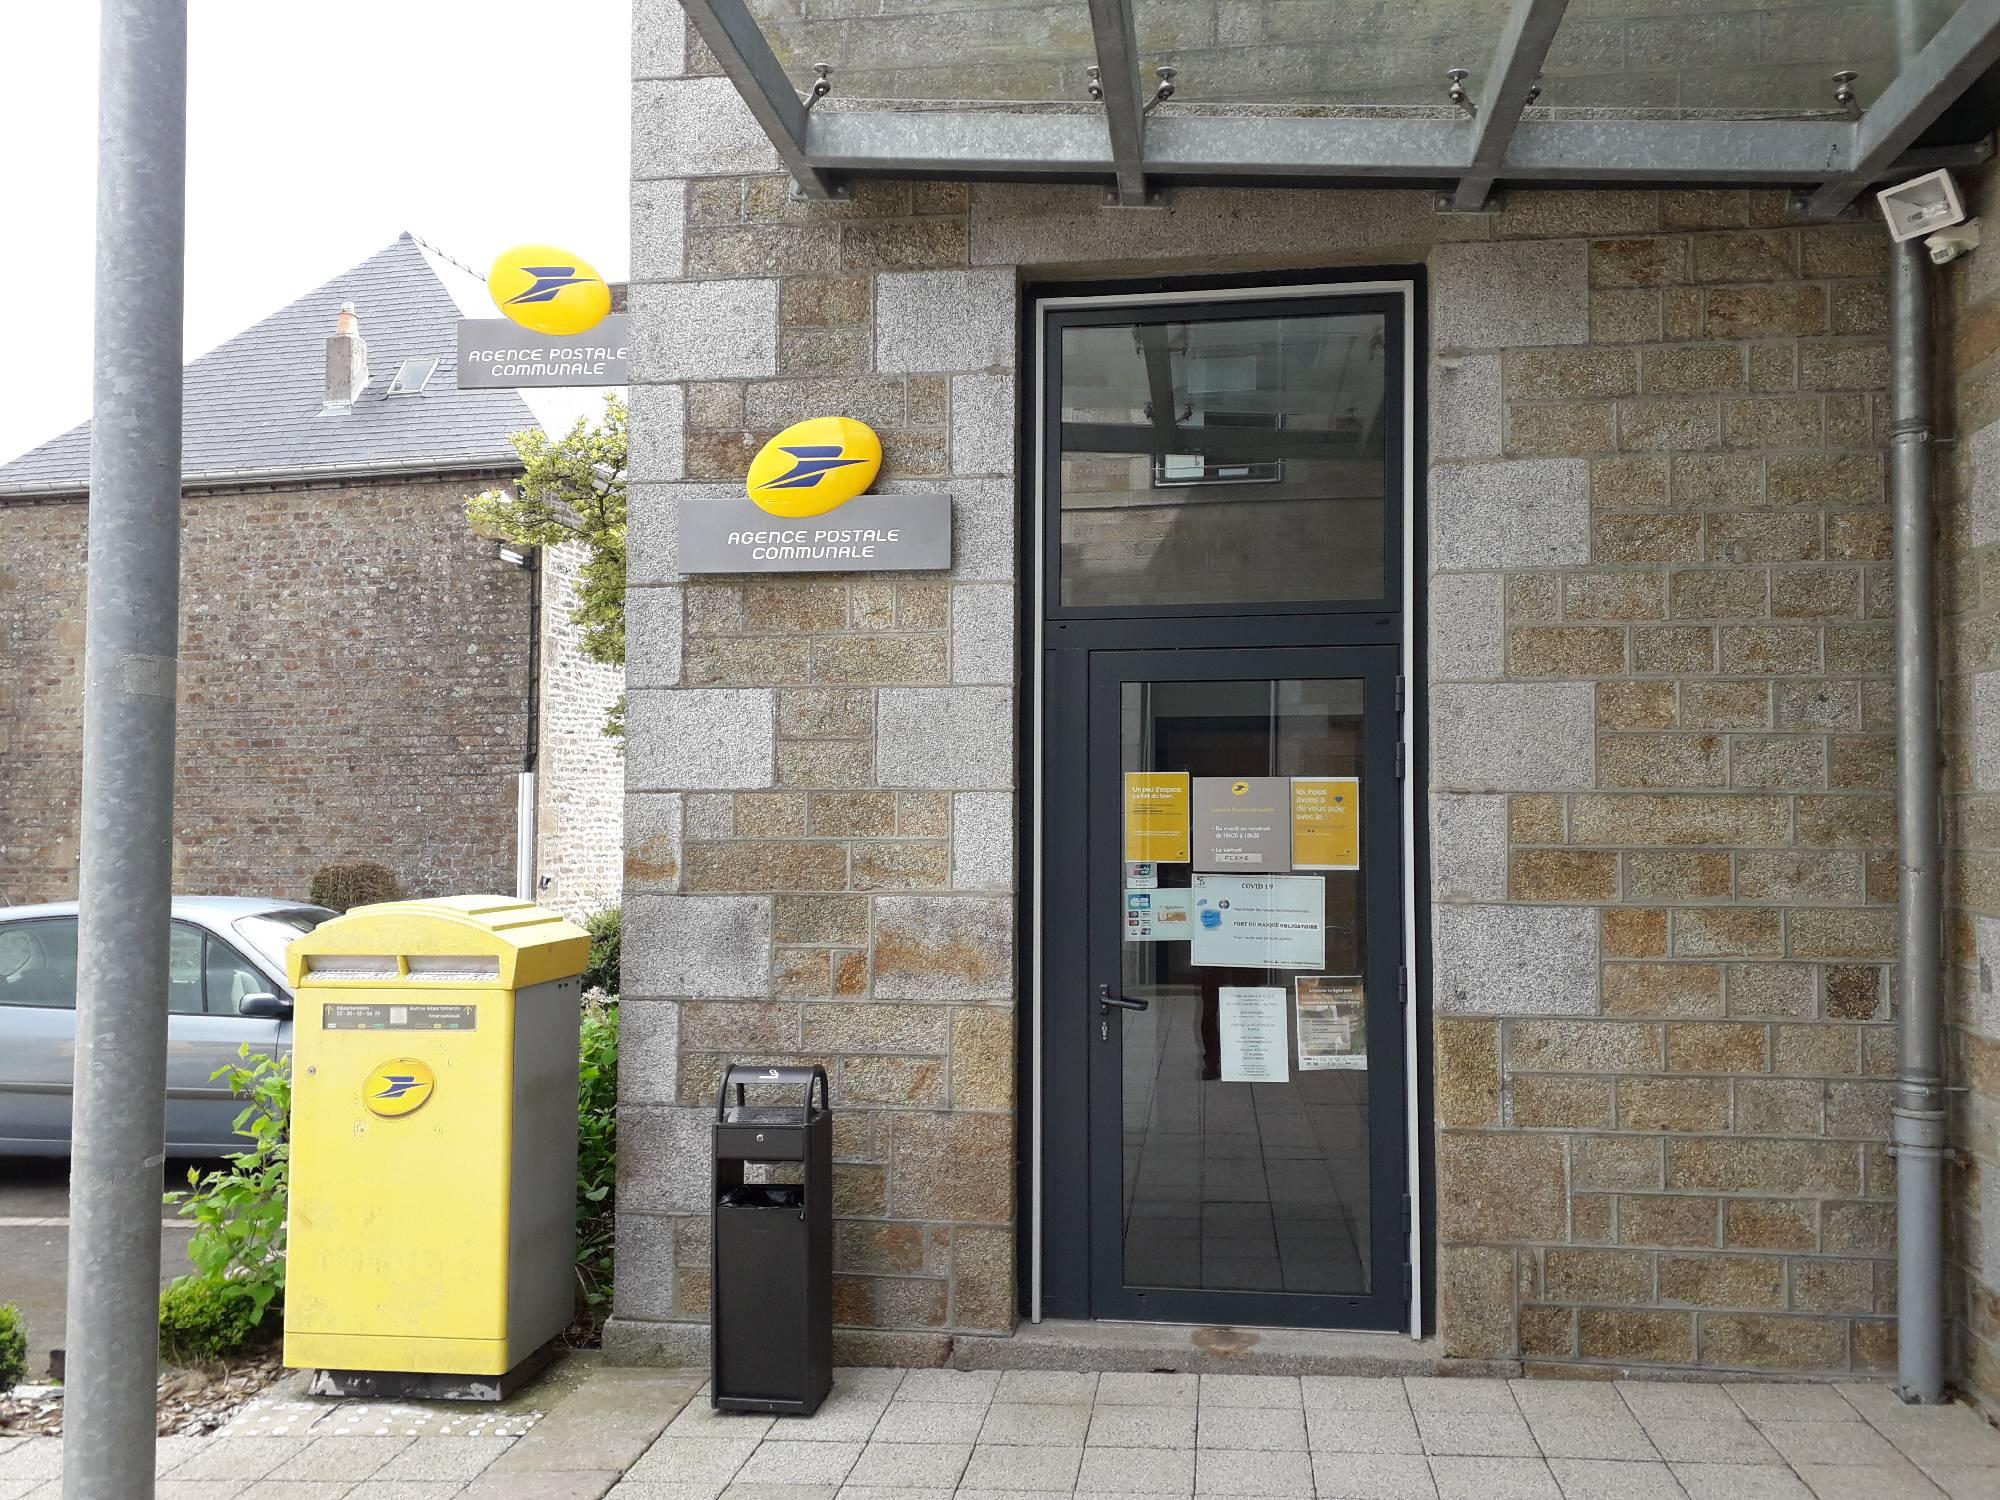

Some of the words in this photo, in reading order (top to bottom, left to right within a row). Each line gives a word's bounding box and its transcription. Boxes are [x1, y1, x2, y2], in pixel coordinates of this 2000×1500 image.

[468, 349, 544, 362] AGENCE
[549, 347, 628, 360] POSTALE
[491, 362, 606, 377] COMMUNALE
[727, 530, 809, 545] AGENCE
[814, 529, 900, 543] POSTALE
[752, 545, 875, 560] COMMUNALE
